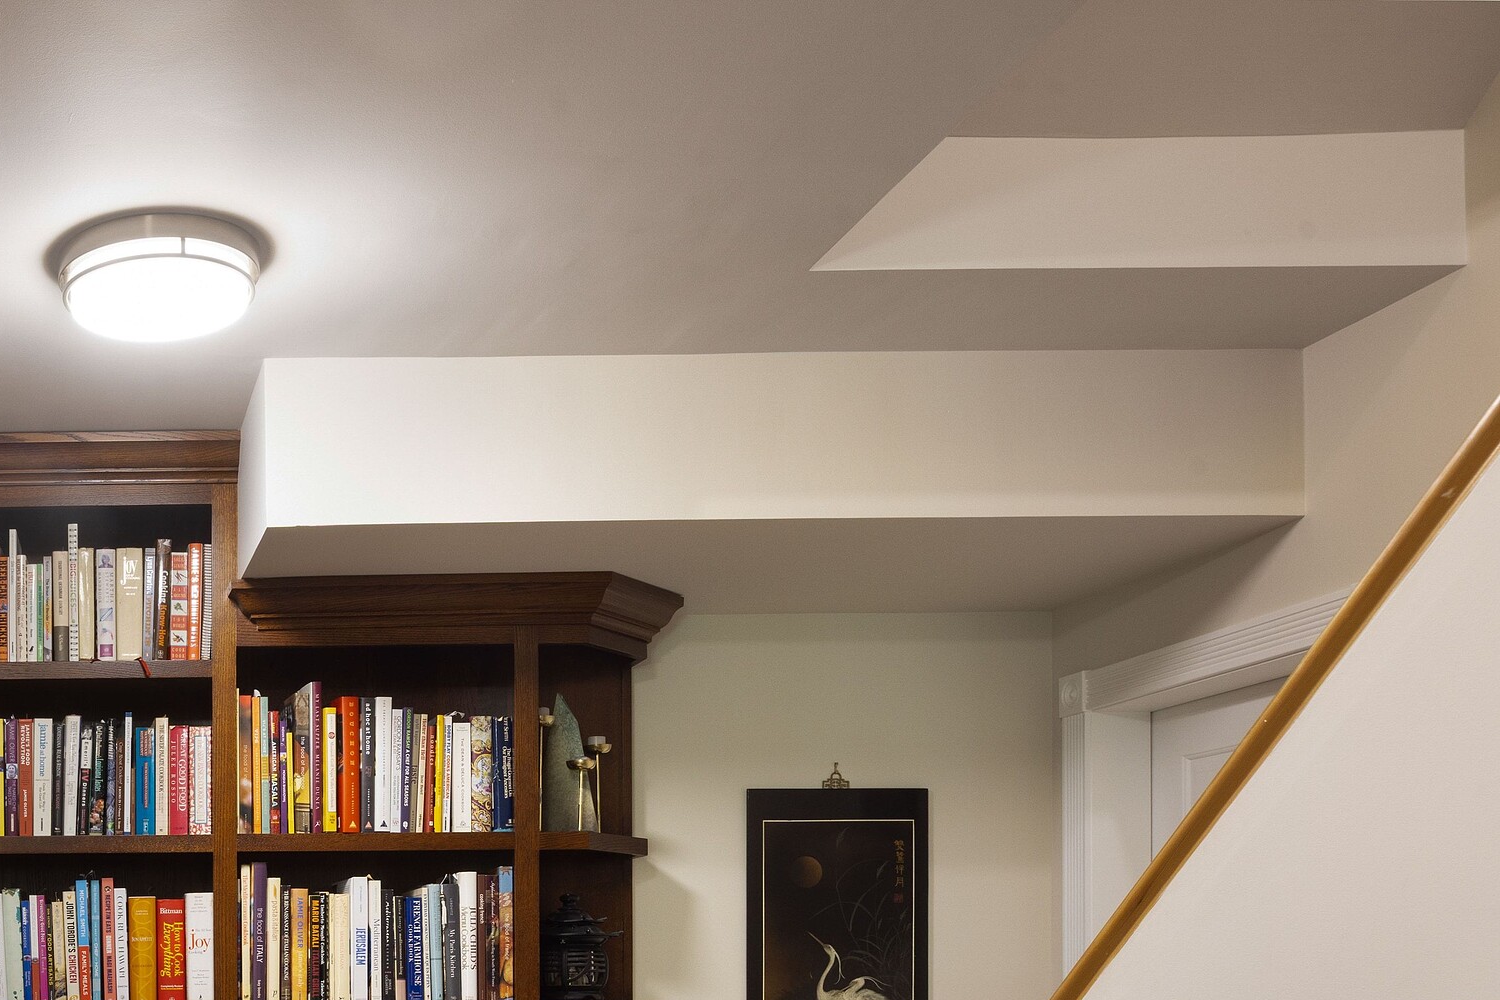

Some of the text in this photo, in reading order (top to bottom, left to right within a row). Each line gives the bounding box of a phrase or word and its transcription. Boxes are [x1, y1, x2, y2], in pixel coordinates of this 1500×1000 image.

[348, 701, 356, 770] BOUCHON
[270, 773, 279, 808] MASALA
[159, 907, 183, 915] Bittman
[296, 896, 305, 949] JAMIE OLIVER
[469, 906, 477, 971] JULIA CHILD'S
[66, 901, 77, 984] JOHN TORODE'S CHICKEN
[159, 921, 175, 978] Everything
[355, 927, 367, 966] JERUSALEM
[413, 900, 422, 987] FRENCH FARMHOUSE
